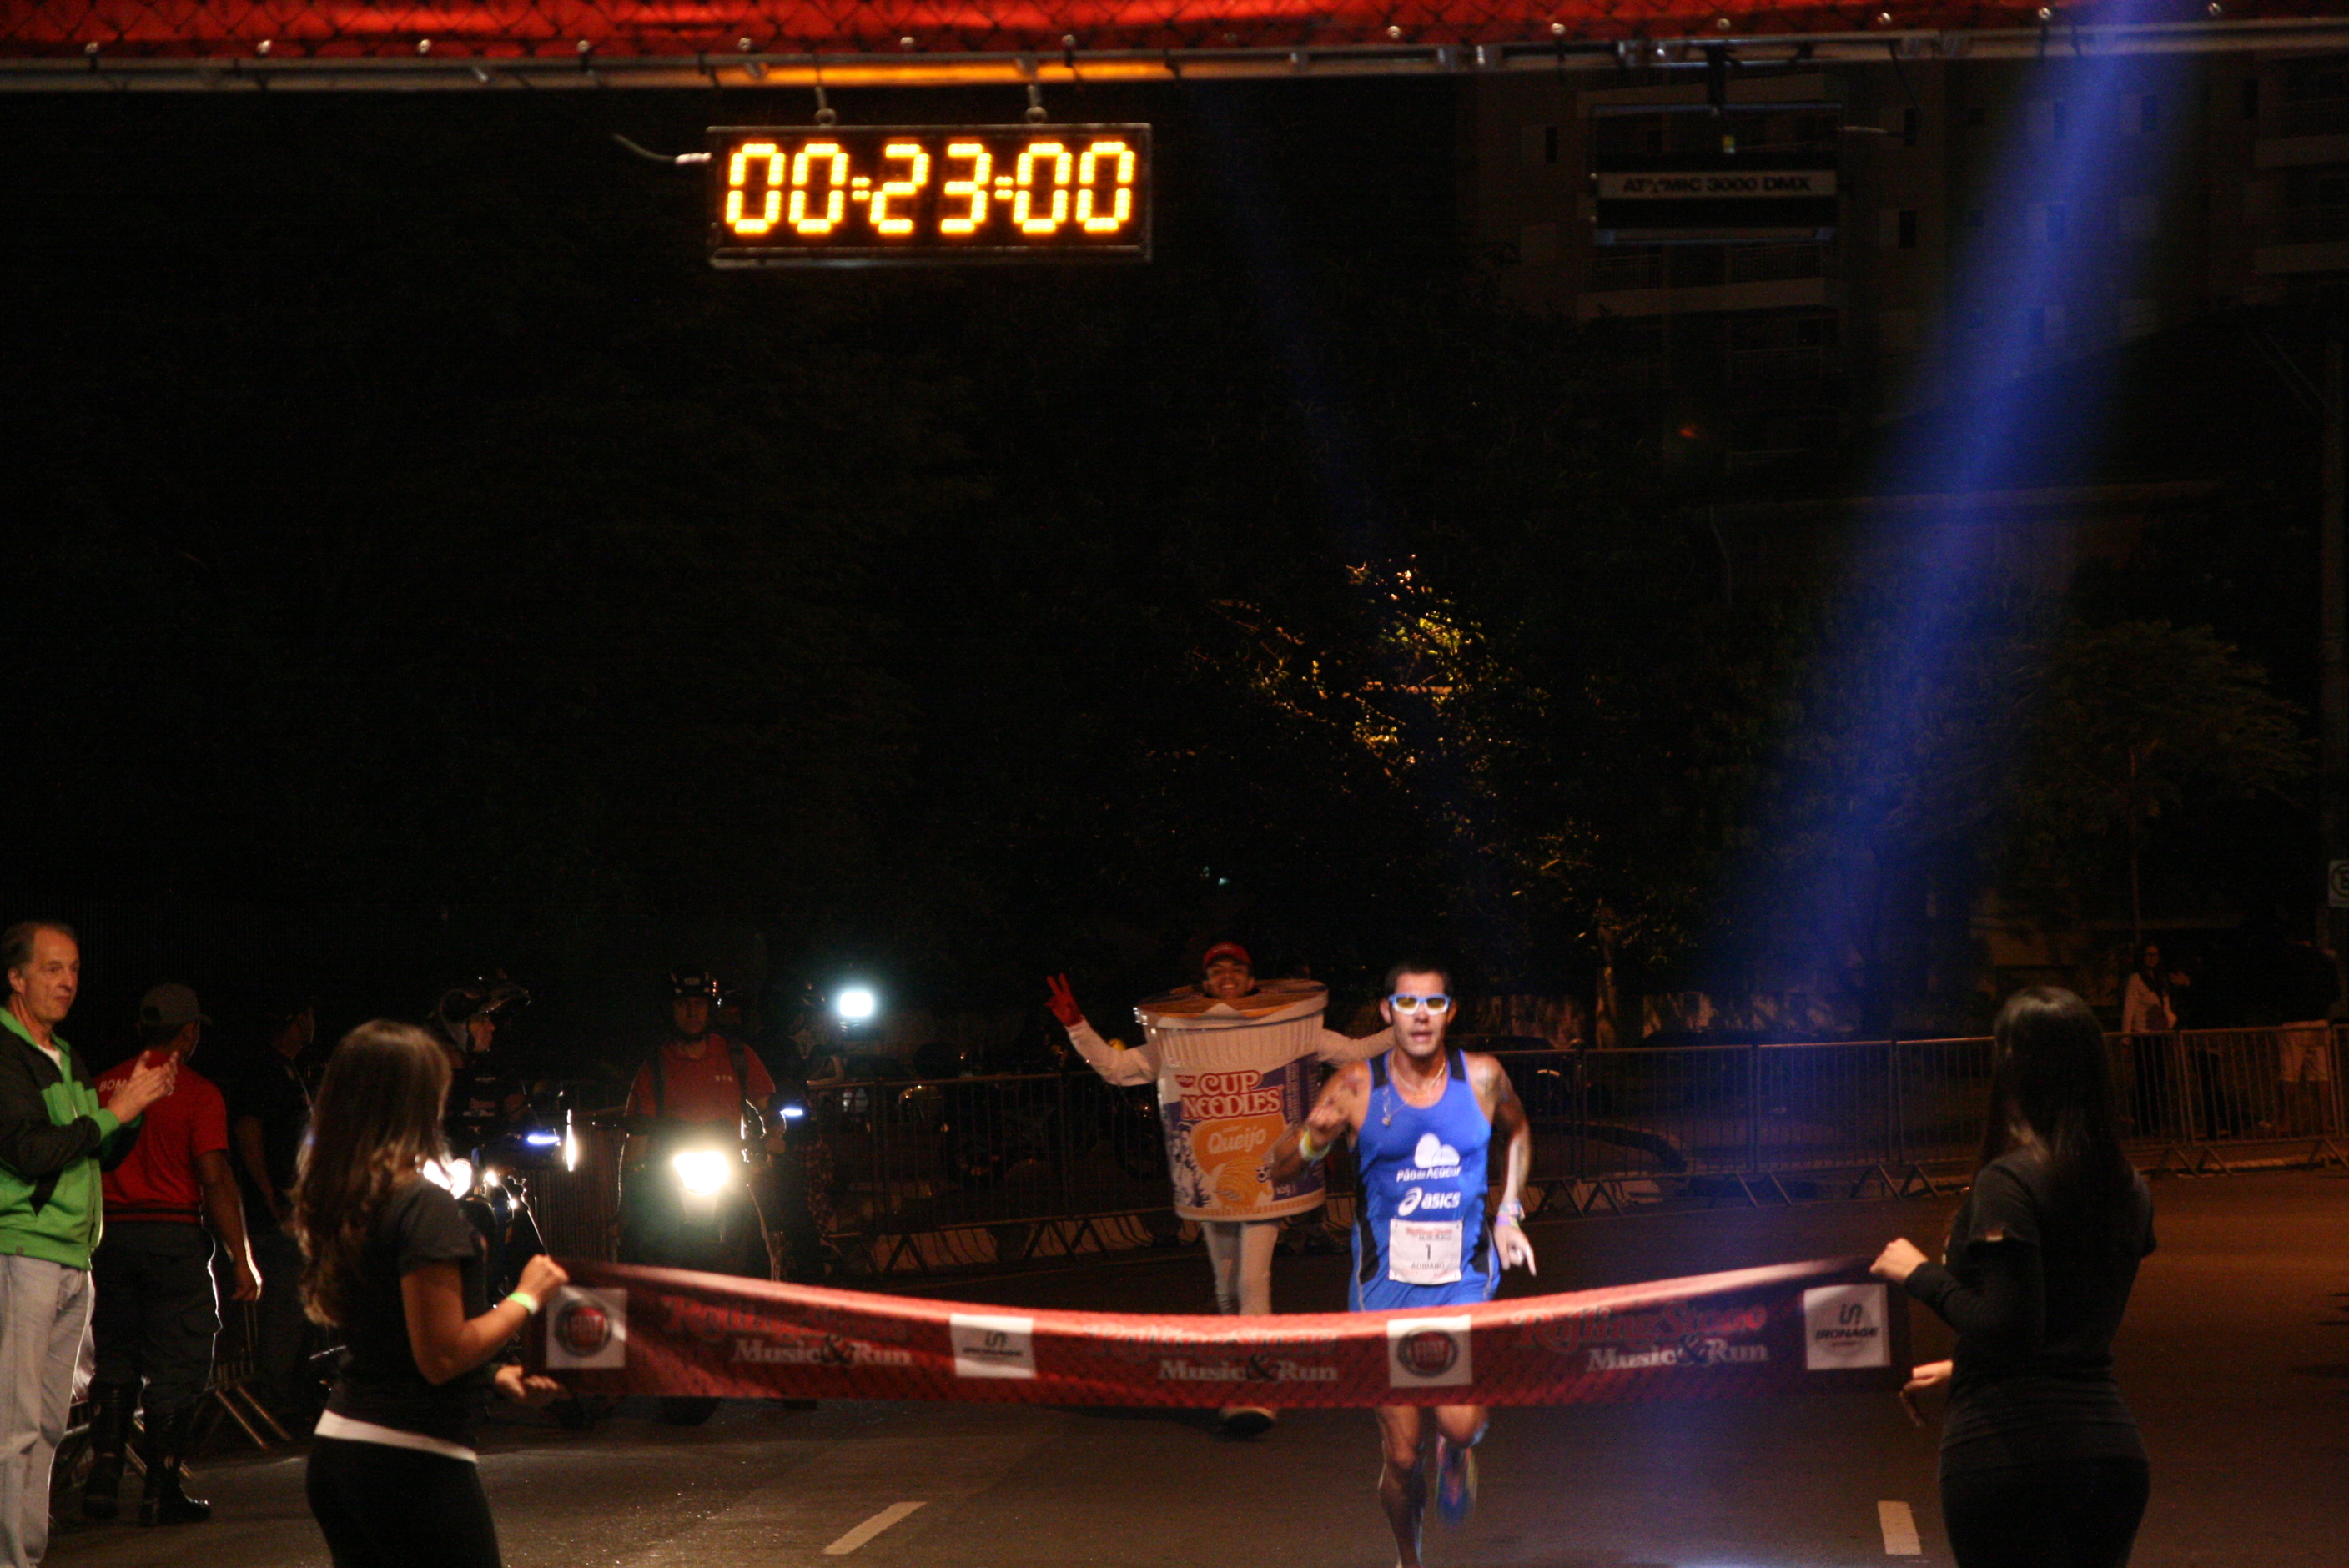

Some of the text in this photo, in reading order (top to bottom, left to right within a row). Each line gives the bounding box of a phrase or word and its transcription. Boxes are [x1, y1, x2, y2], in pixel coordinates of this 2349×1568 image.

[725, 141, 1136, 234] 00:23:00
[1707, 176, 1758, 192] 3000
[1763, 175, 1812, 191] DMX
[1199, 1071, 1262, 1097] CUP
[1181, 1088, 1282, 1120] NOODLES
[1208, 1126, 1266, 1155] Queijo
[1426, 1244, 1431, 1261] 1
[1587, 1344, 1677, 1372] Music
[1704, 1338, 1769, 1366] Run
[1158, 1359, 1249, 1381] Music
[1273, 1359, 1338, 1383] Run
